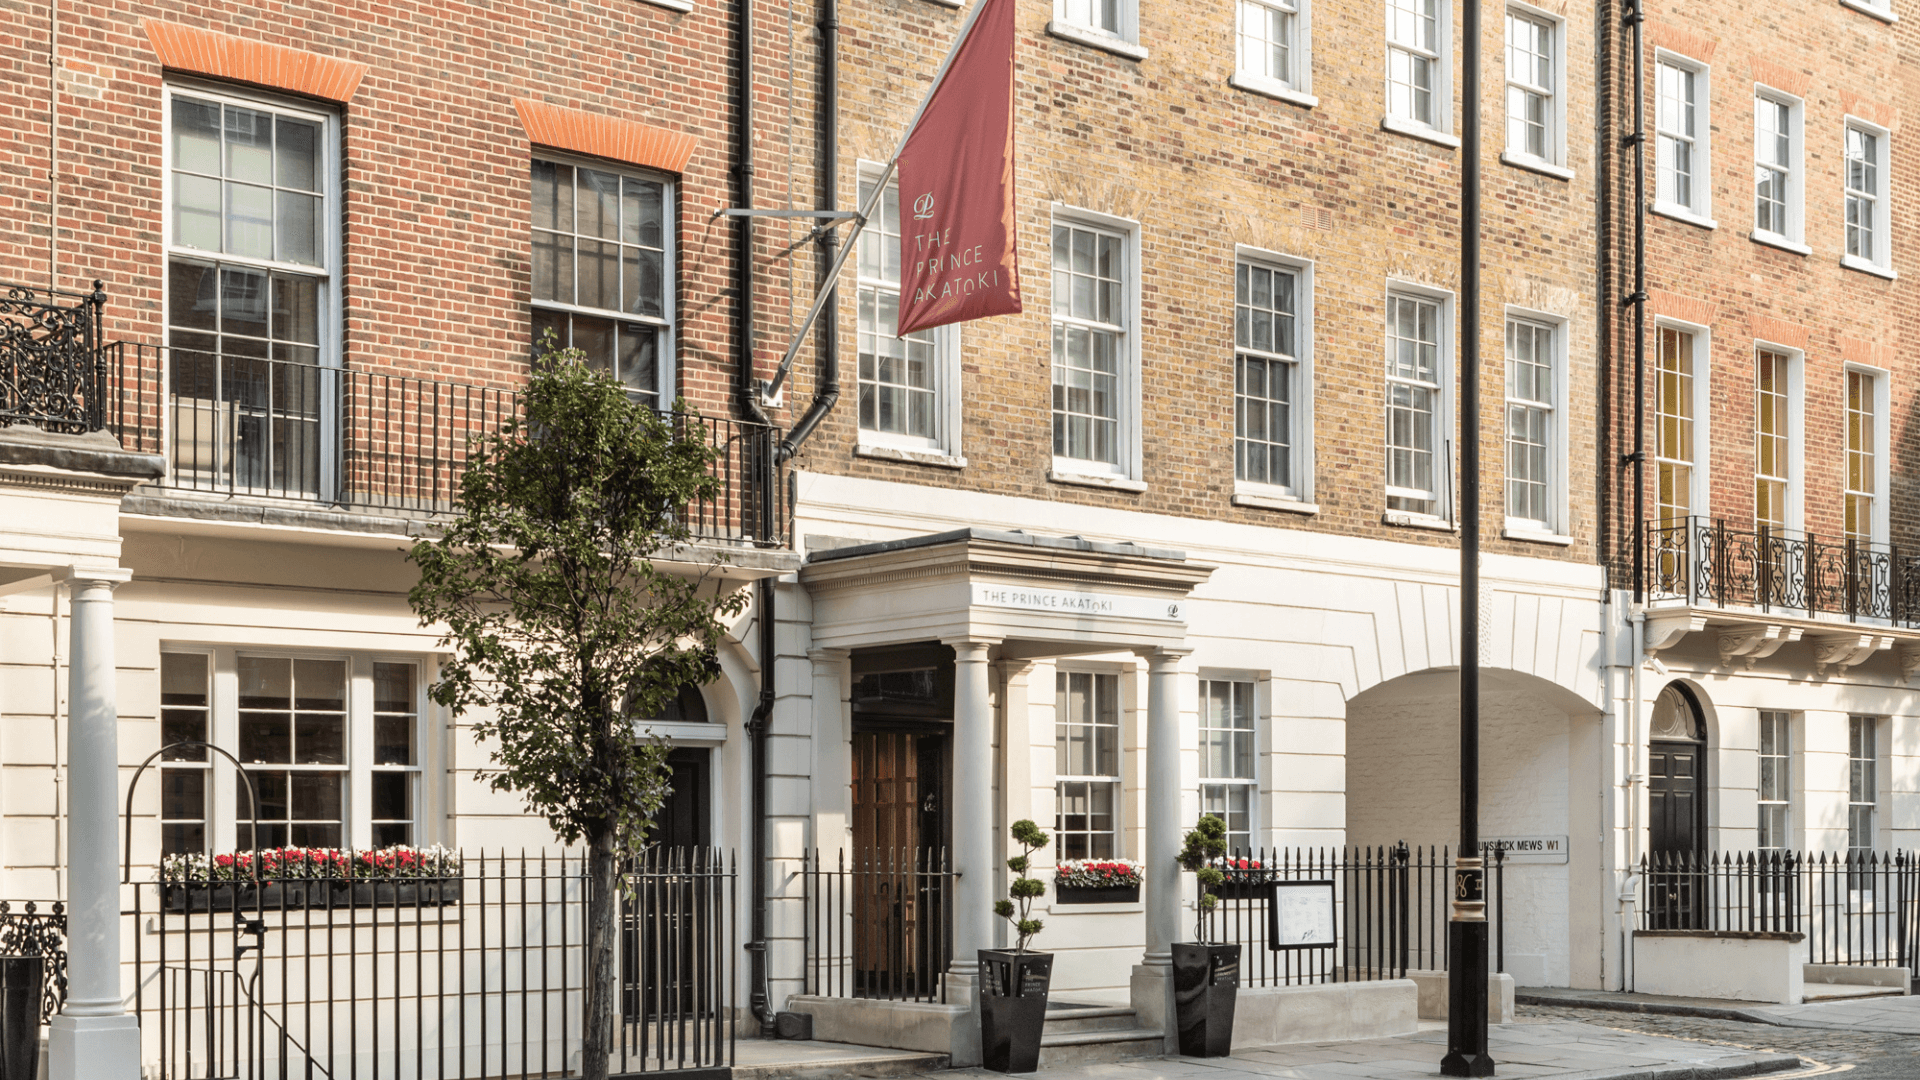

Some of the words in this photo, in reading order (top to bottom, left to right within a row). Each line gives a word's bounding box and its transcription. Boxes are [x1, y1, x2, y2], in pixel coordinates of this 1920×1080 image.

[915, 227, 951, 252] THE
[916, 245, 983, 279] PRINCE
[914, 270, 998, 305] AKATOKI
[983, 590, 1007, 603] THE
[1012, 593, 1057, 607] PRINCE
[1062, 597, 1113, 613] AKATOKI
[1478, 840, 1515, 851] UNSWICK
[1517, 840, 1543, 851] MEWS
[1546, 840, 1559, 850] W1
